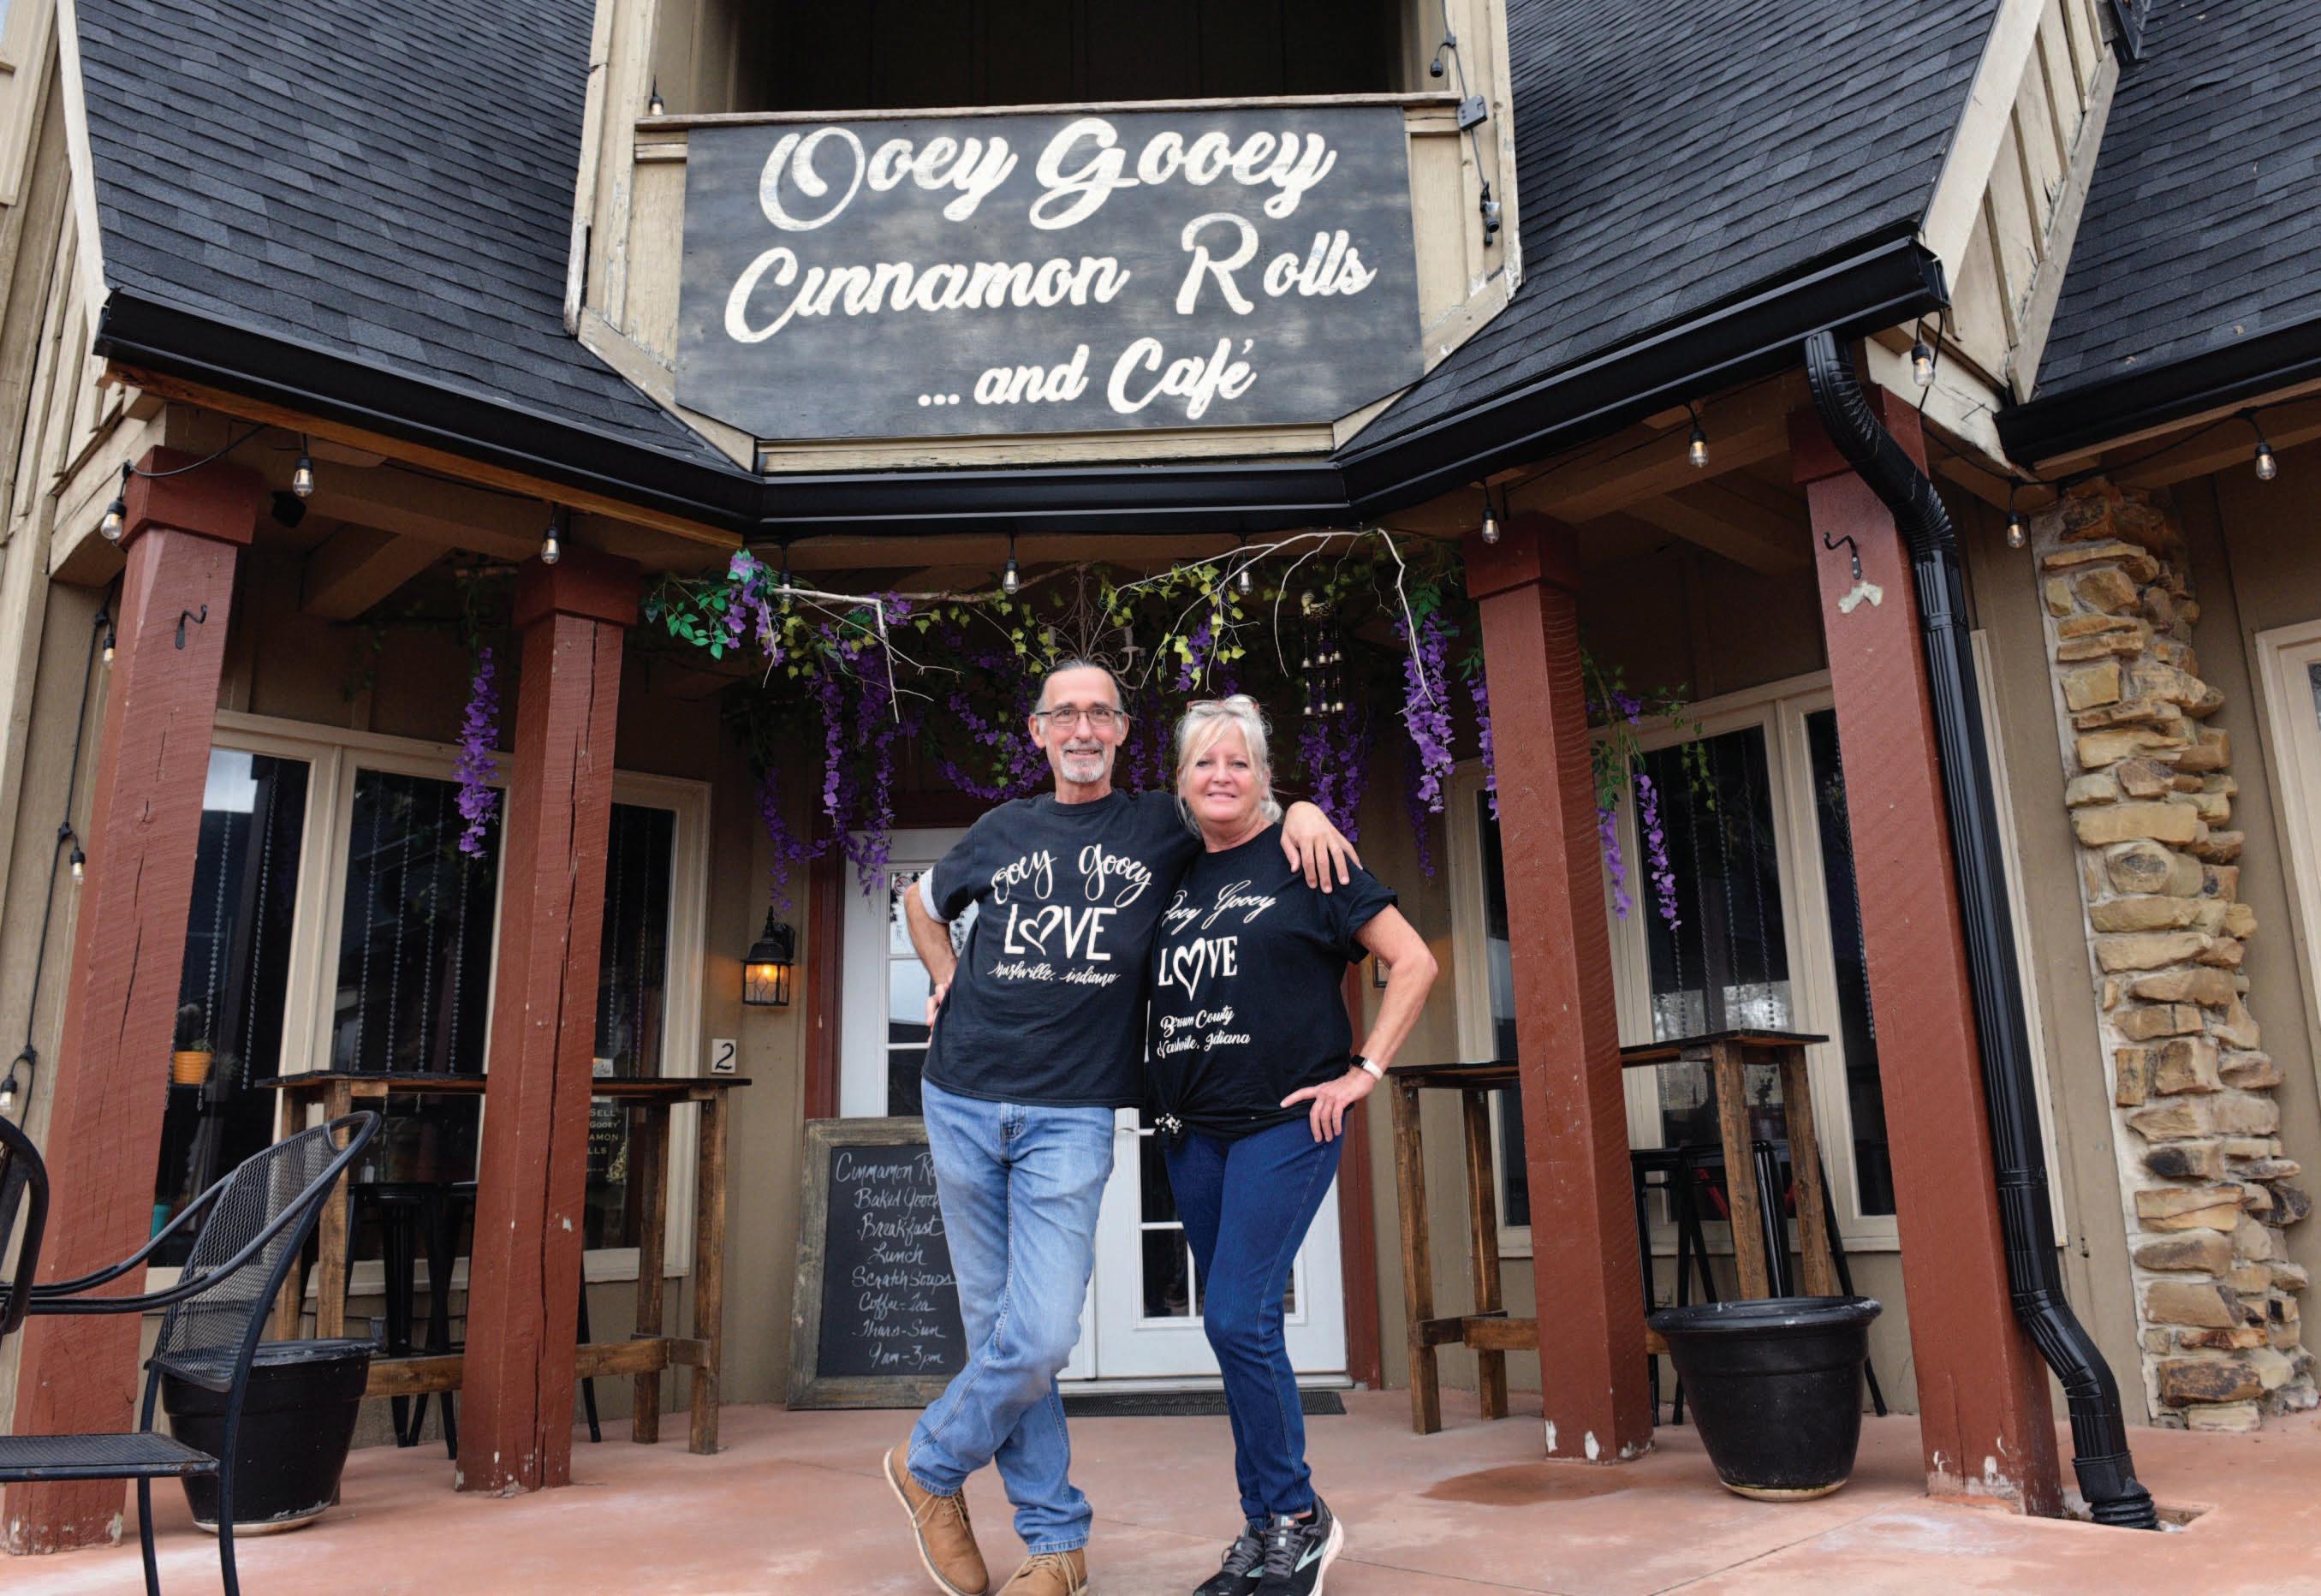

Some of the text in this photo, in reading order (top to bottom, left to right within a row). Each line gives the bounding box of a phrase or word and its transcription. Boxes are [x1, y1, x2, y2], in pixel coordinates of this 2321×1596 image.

[759, 117, 1337, 232] Ooey Gooey
[723, 212, 1377, 343] Cinnamon Rolls
[1107, 337, 1257, 420] Café
[715, 1042, 735, 1070] 2
[854, 1188, 902, 1209] Baked
[857, 1212, 946, 1246] Breakfast
[867, 1242, 928, 1265] Lunch
[852, 1265, 958, 1295] Scratch Soups
